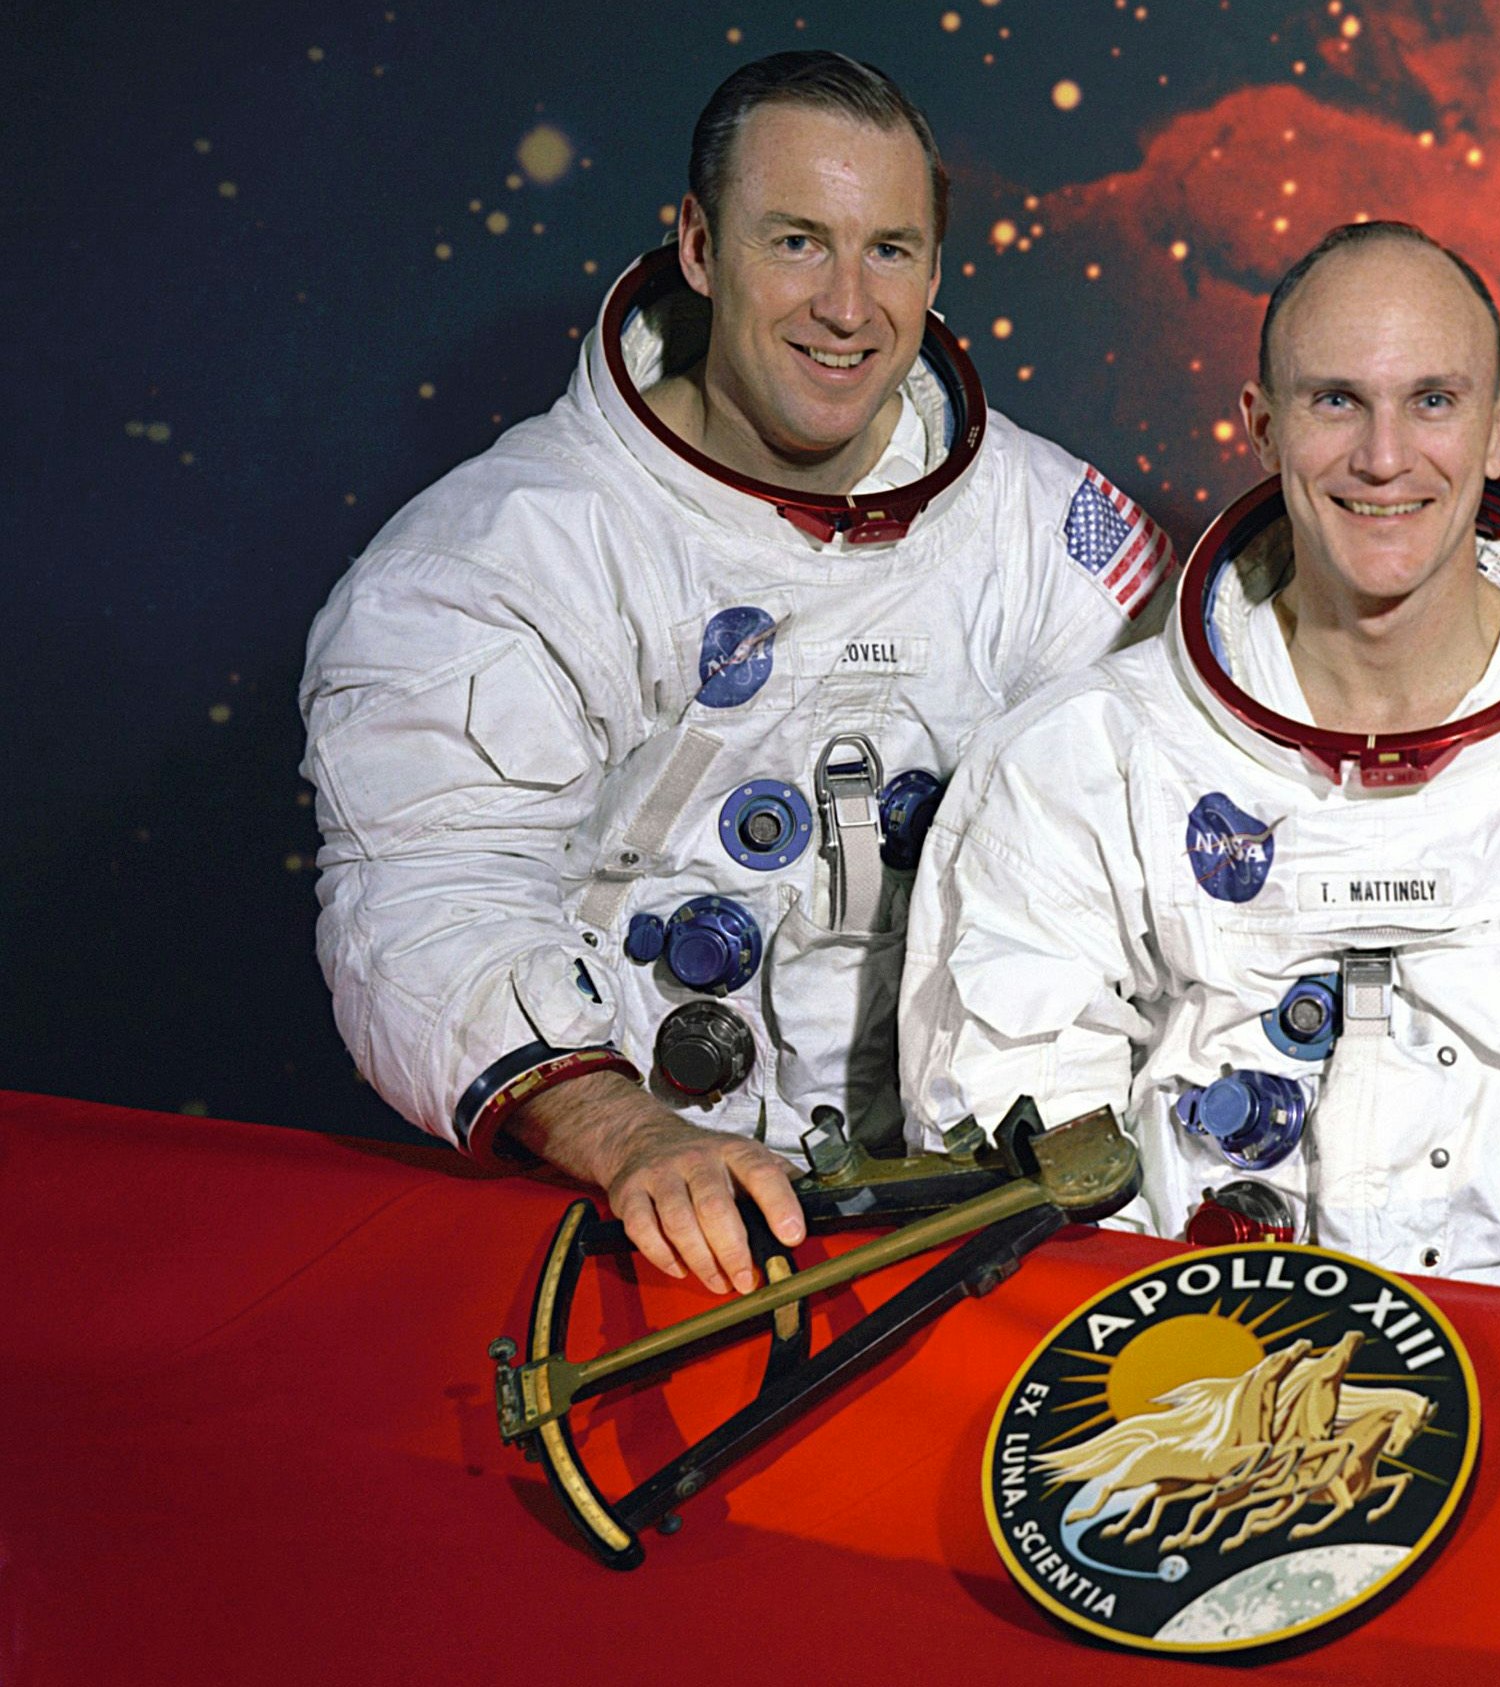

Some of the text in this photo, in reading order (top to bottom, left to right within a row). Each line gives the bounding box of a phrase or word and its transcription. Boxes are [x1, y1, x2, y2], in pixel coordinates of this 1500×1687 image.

[1194, 830, 1268, 864] NASA
[1321, 880, 1437, 903] T. MATTINGLY
[1086, 1255, 1445, 1370] APOLLO XIII
[999, 1382, 1117, 1619] EX LUNA, SCIENTIA
